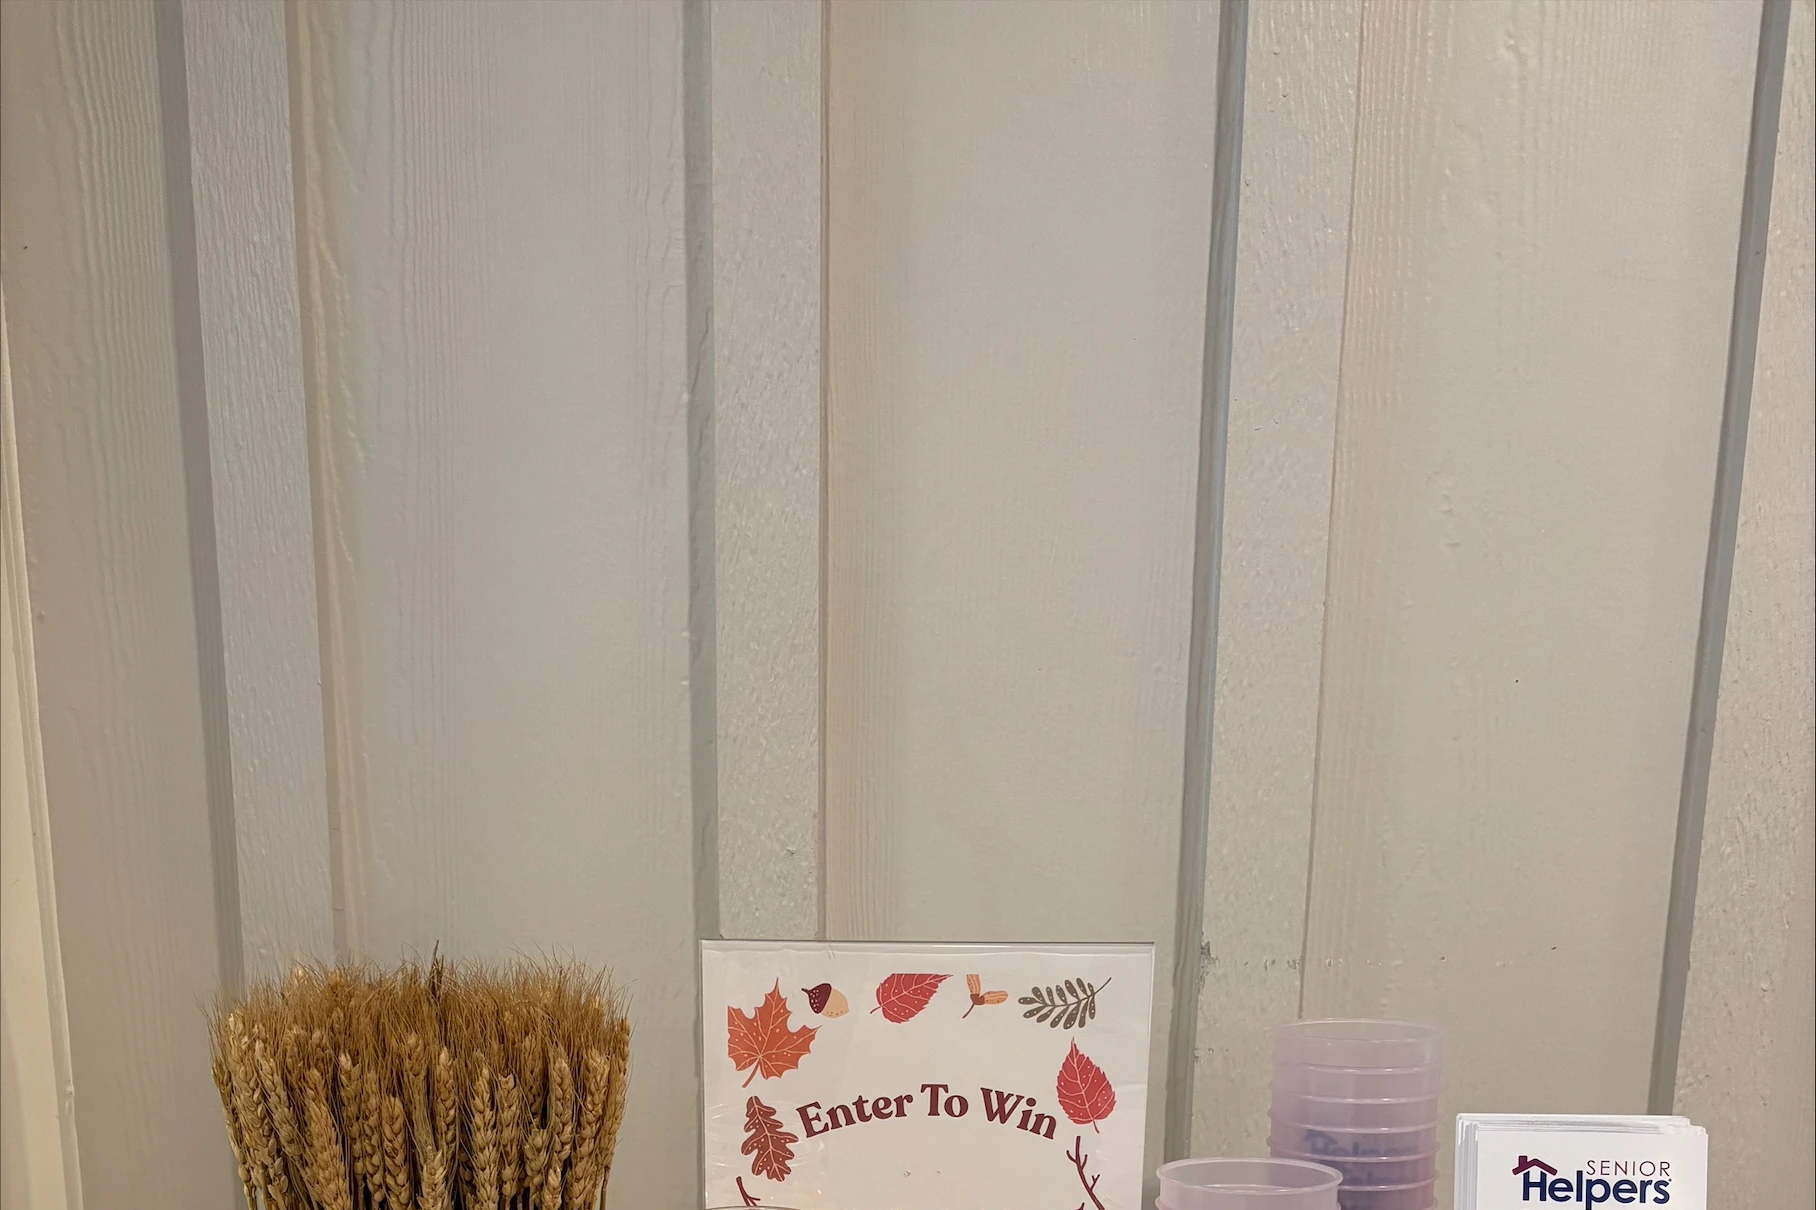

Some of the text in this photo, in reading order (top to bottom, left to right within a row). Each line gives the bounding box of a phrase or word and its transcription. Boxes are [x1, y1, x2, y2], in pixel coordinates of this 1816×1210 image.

[796, 1084, 1057, 1139] Enter To Win
[1586, 1160, 1670, 1177] SENIOR
[1522, 1170, 1671, 1210] Helpers
